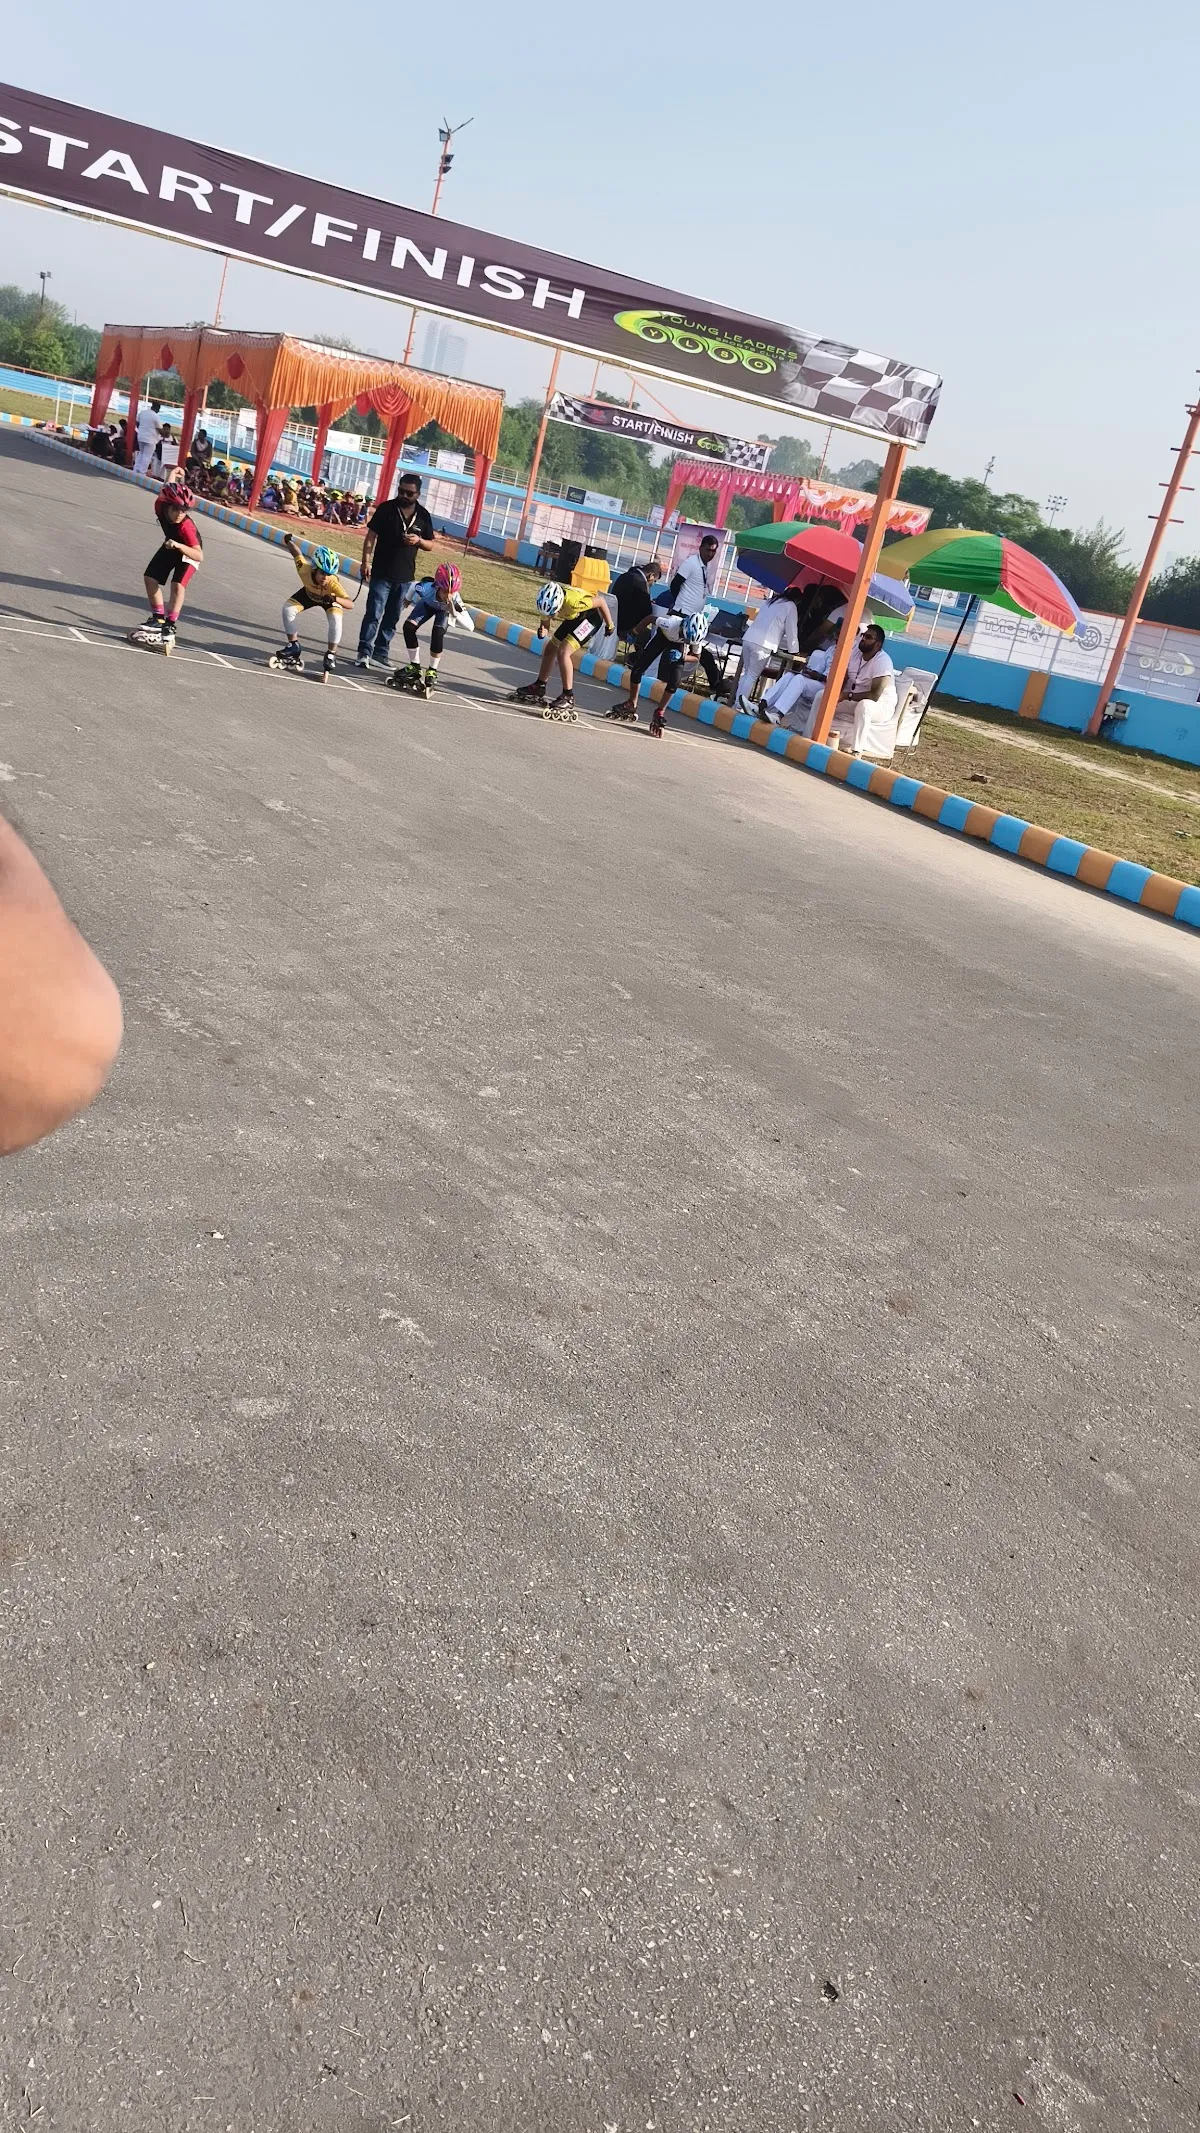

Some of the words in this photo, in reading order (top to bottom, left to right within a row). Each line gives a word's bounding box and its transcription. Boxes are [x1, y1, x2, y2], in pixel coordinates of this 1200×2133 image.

[649, 329, 658, 337] Y
[685, 340, 694, 348] L
[720, 349, 729, 358] S
[754, 361, 764, 369] C
[658, 312, 719, 337] YOUNG
[724, 331, 799, 360] LEADERS
[715, 337, 756, 352] SPORTS
[759, 350, 785, 363] CLUB
[612, 415, 694, 445] START/FINISH
